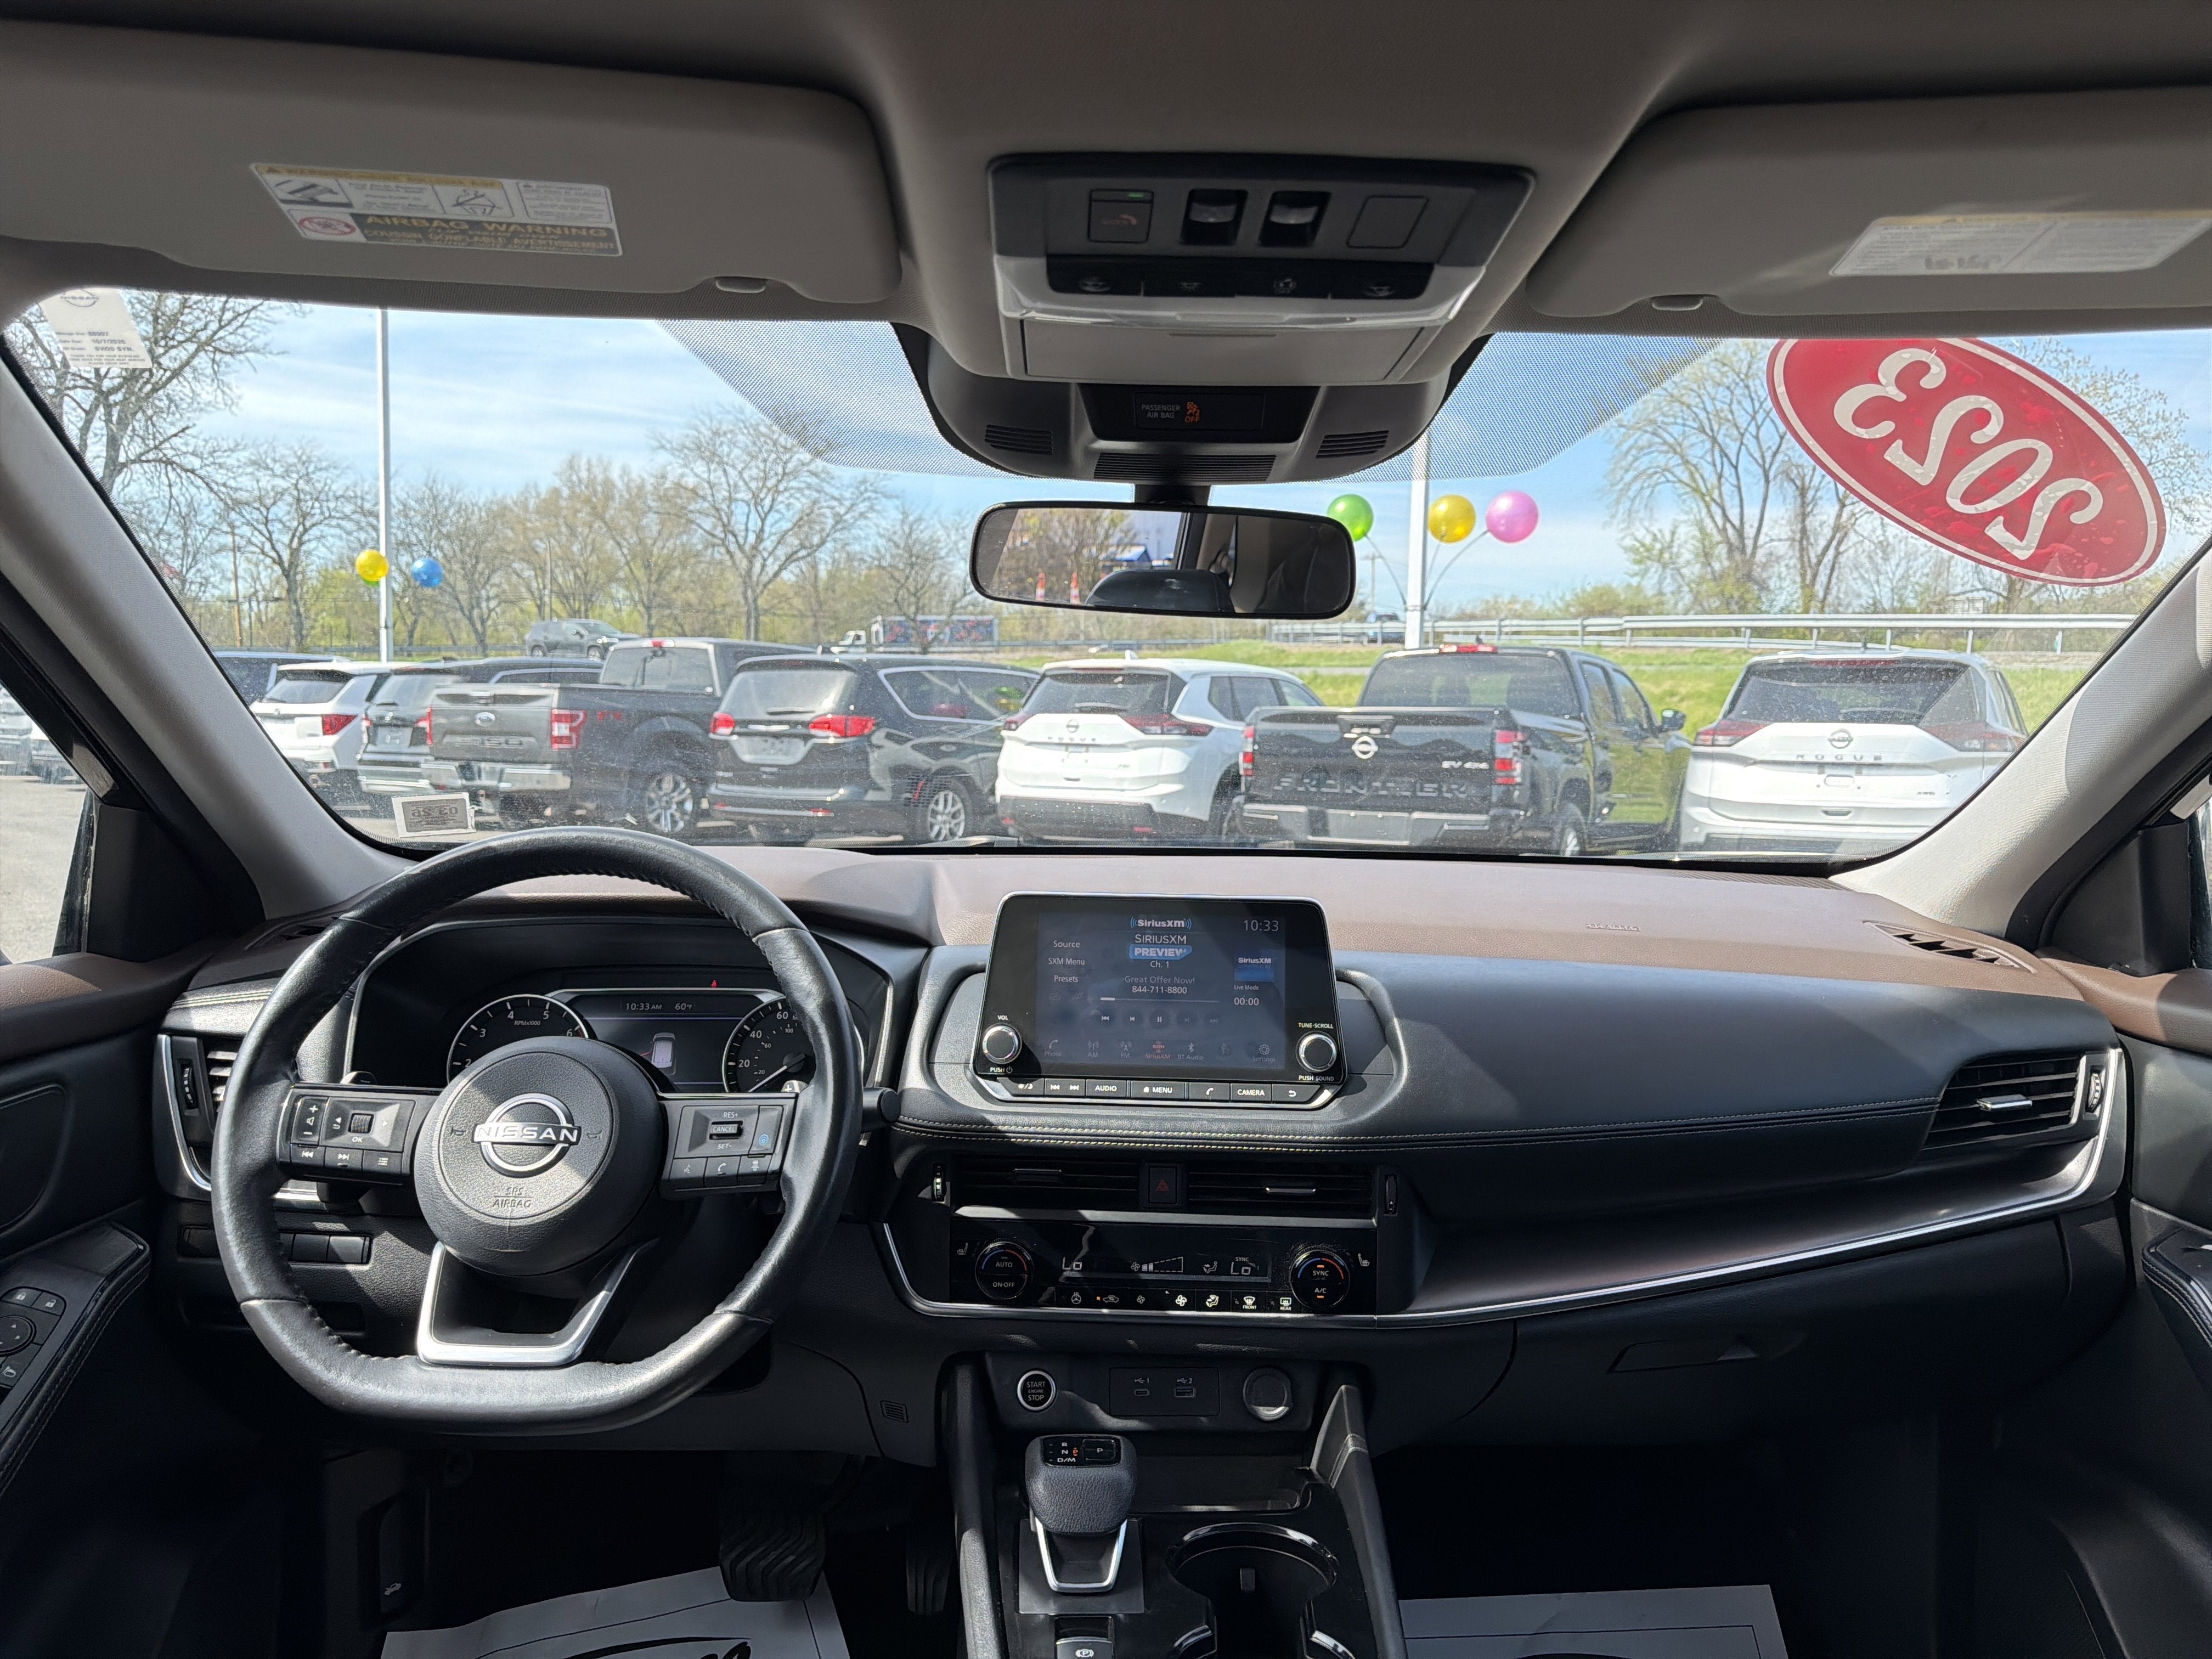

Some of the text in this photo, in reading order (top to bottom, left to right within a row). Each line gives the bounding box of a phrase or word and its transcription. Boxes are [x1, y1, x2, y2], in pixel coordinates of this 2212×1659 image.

[367, 216, 469, 229] AIRBAG
[482, 223, 607, 237] WARNING
[1243, 919, 1279, 932] 10:33
[1135, 934, 1187, 944] SIRIUSXM
[1135, 947, 1187, 957] PREVIEW
[1132, 985, 1187, 994] 844-711-8800
[1234, 997, 1259, 1006] 00:00
[507, 1011, 549, 1020] 4 5
[776, 1011, 788, 1019] 60
[479, 1029, 573, 1037] 3 6
[749, 1030, 762, 1039] 40
[465, 1059, 471, 1068] 2
[738, 1059, 750, 1068] 20
[477, 1126, 578, 1142] NISSAN
[505, 1187, 524, 1195] SRS
[493, 1199, 532, 1208] AIRBAG
